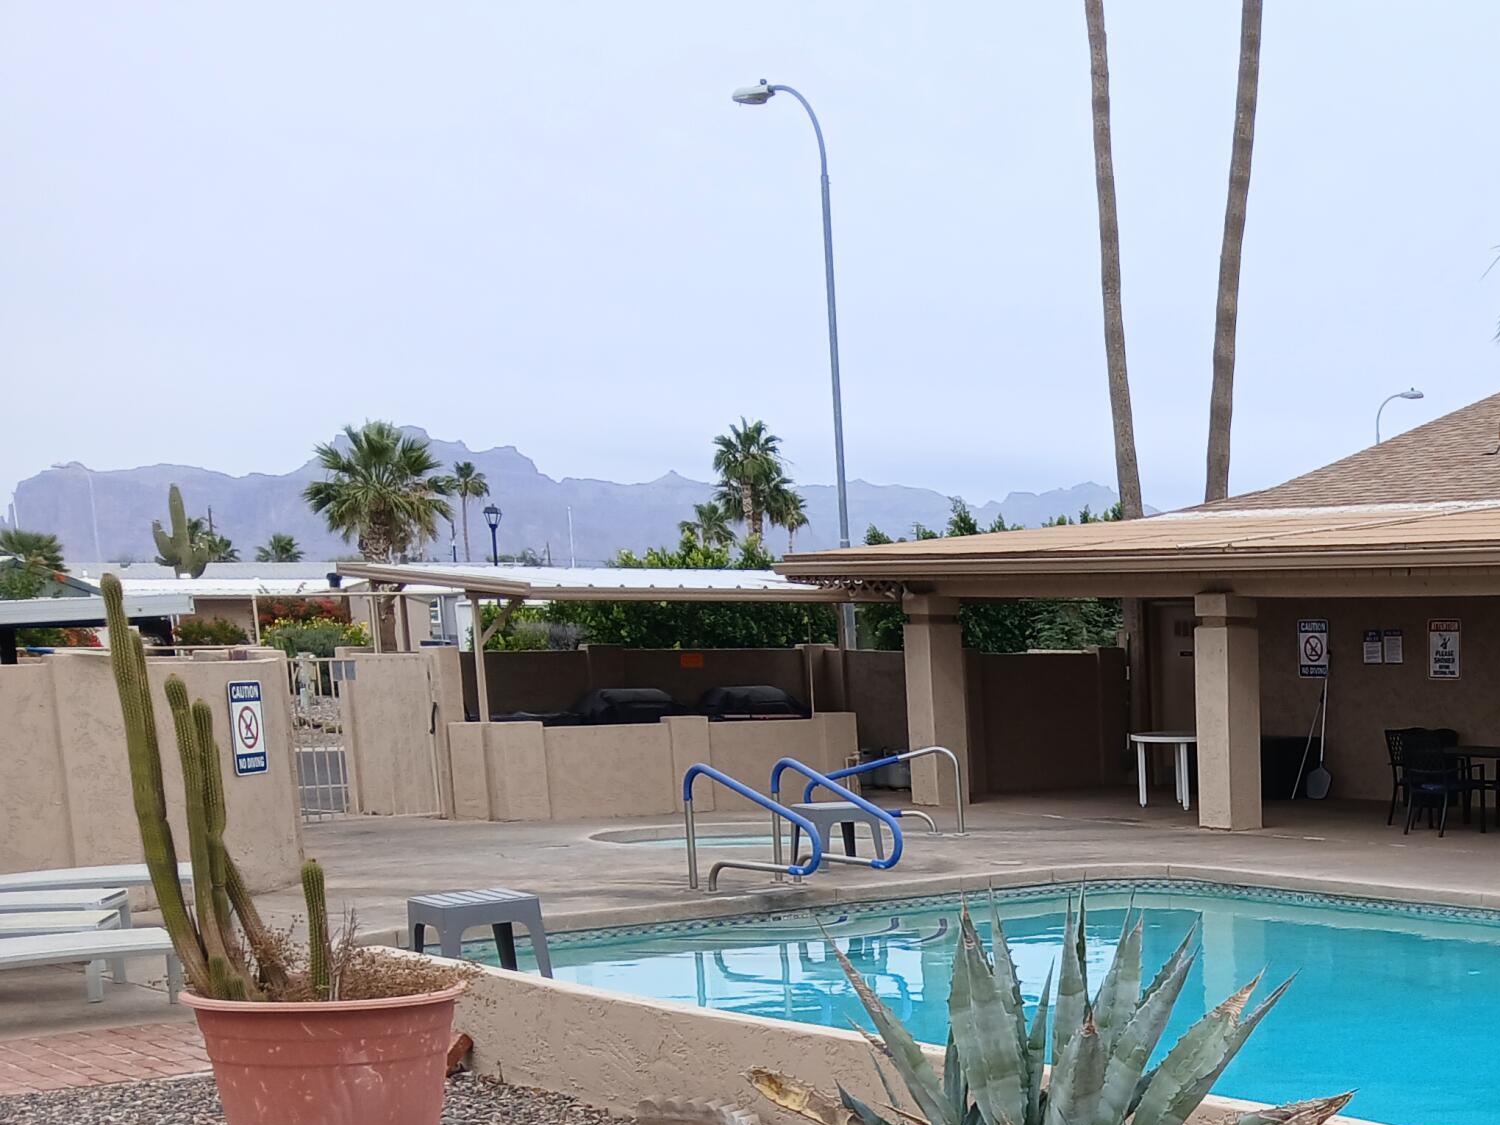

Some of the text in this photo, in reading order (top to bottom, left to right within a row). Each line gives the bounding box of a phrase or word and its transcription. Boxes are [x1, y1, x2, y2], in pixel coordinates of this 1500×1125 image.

[1300, 622, 1326, 631] CAUTION
[231, 685, 259, 699] CAUTION
[238, 756, 265, 769] NO DIVING
